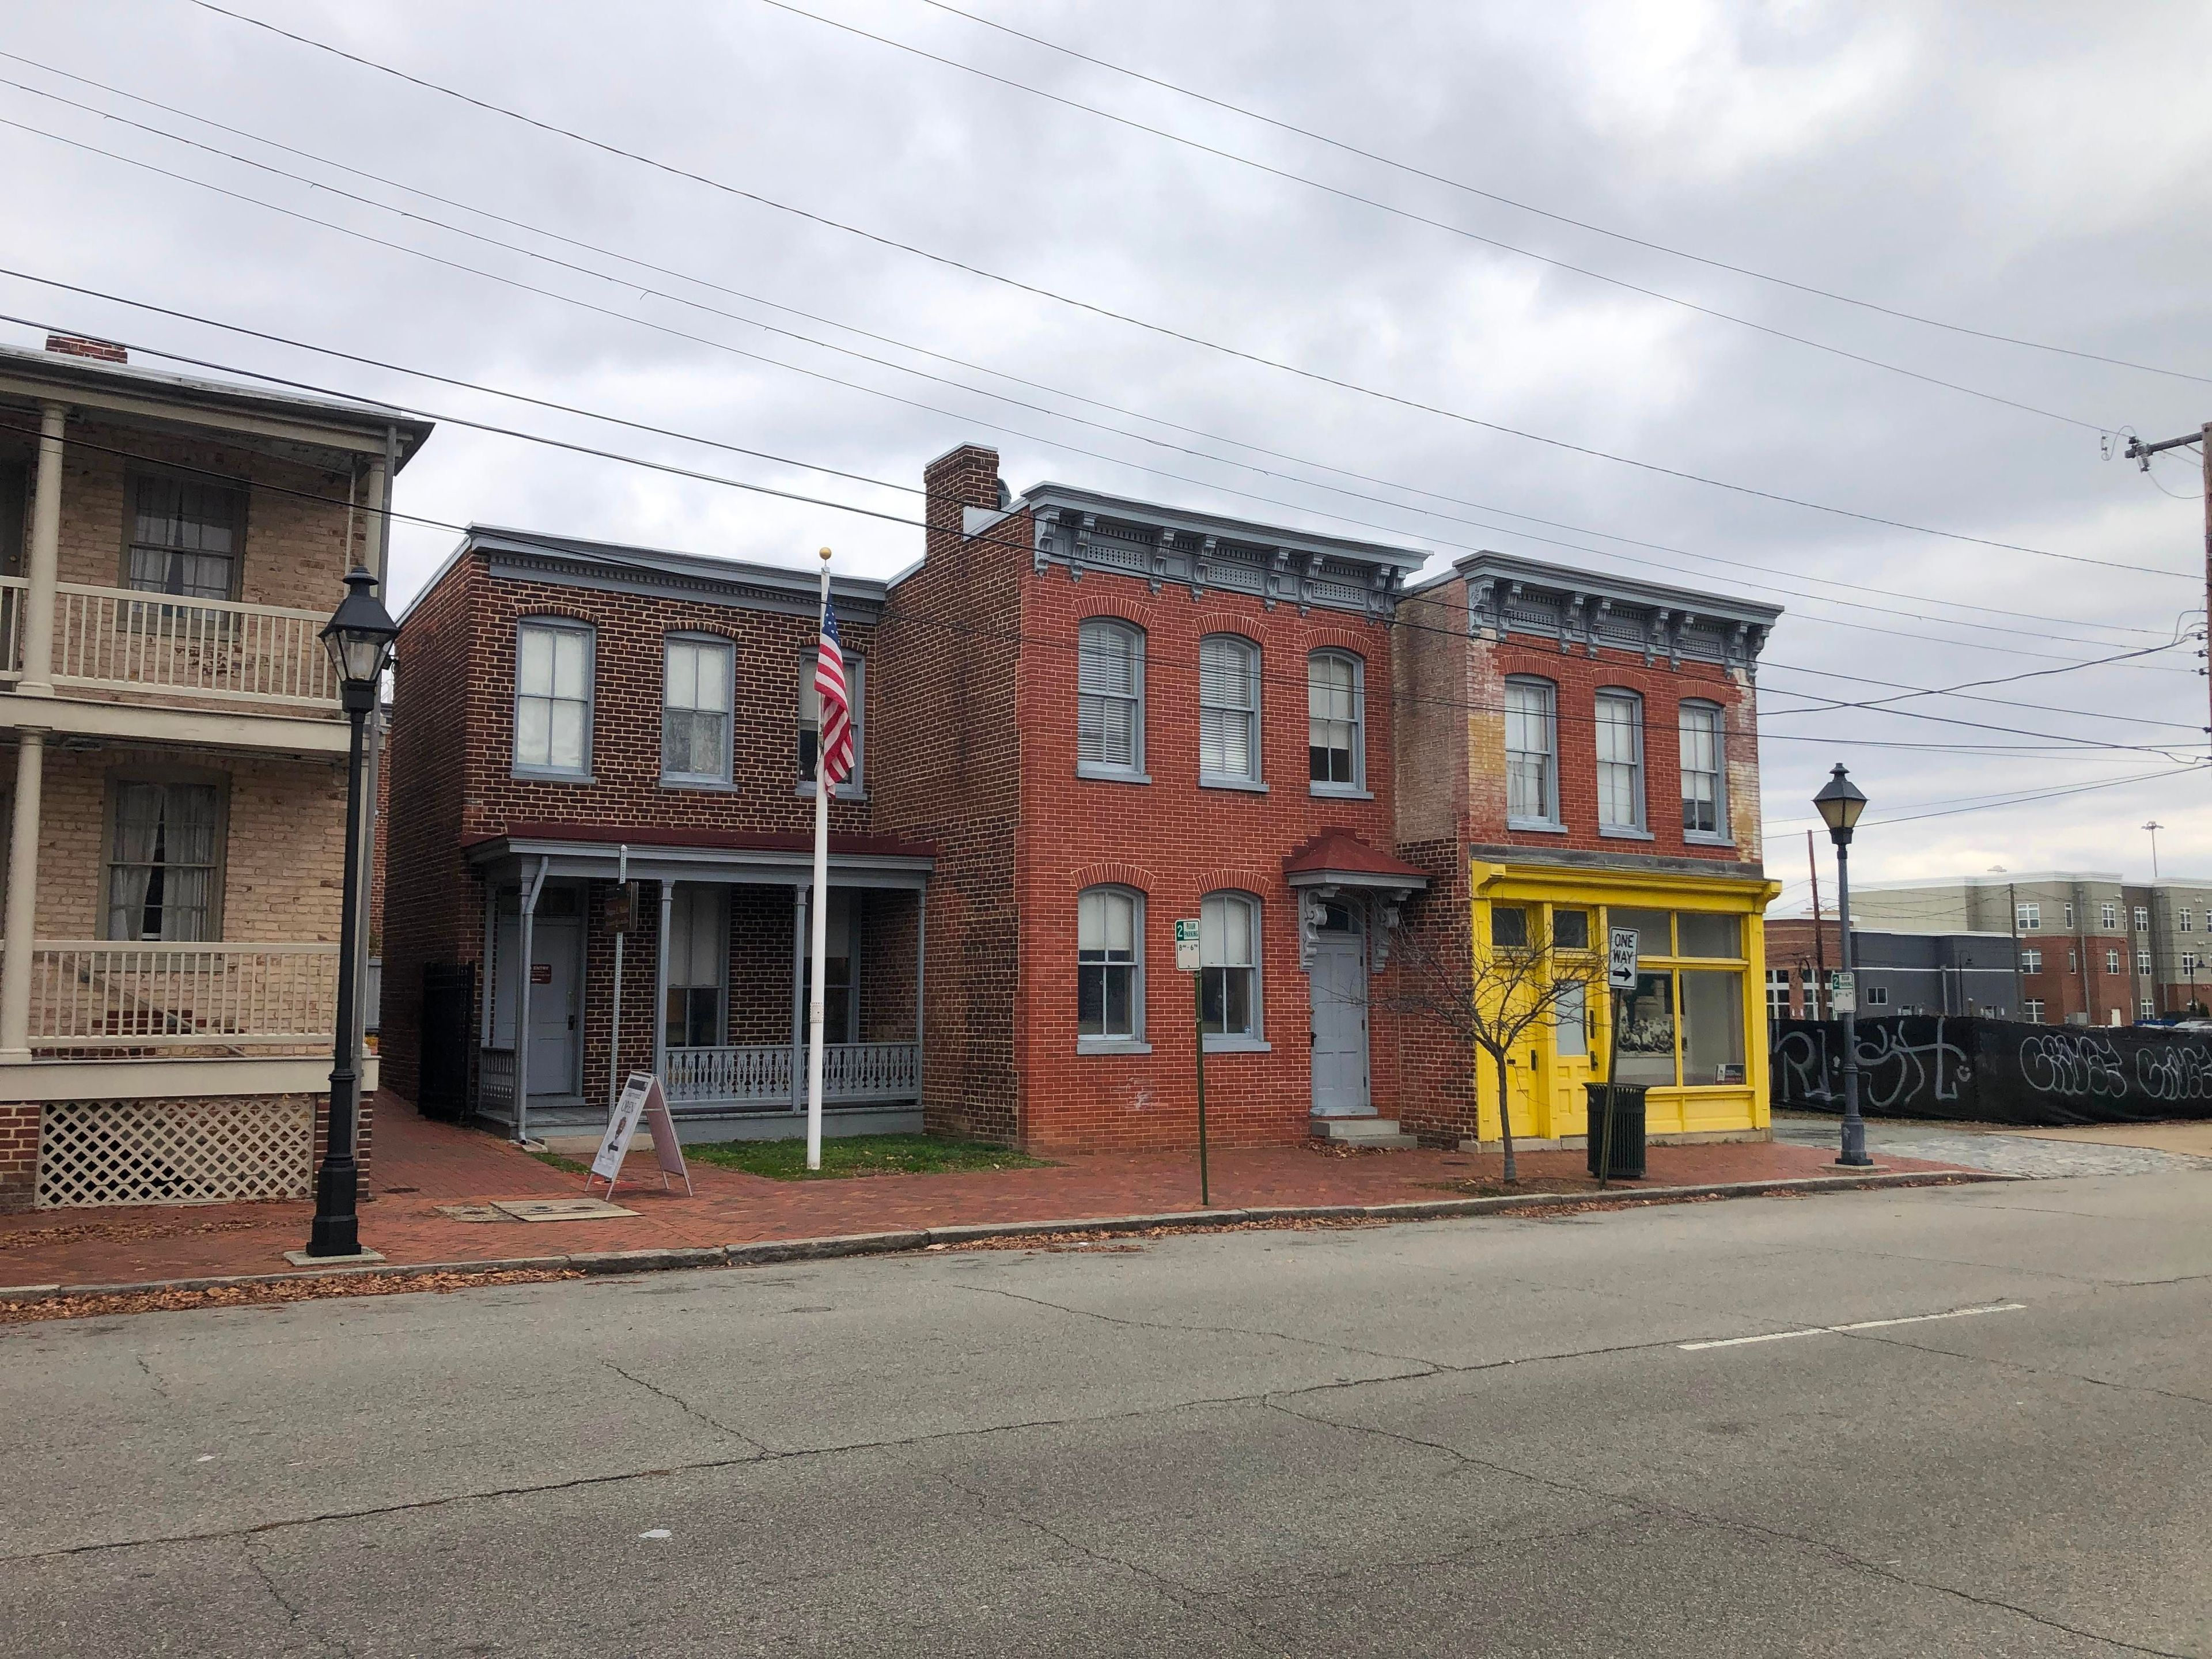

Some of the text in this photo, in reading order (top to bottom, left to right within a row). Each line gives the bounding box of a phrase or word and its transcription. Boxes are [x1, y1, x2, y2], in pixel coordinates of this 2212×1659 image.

[1177, 925, 1183, 938] 2
[1614, 933, 1634, 948] ONE
[1613, 949, 1634, 964] WAY
[1834, 976, 1839, 987] 2
